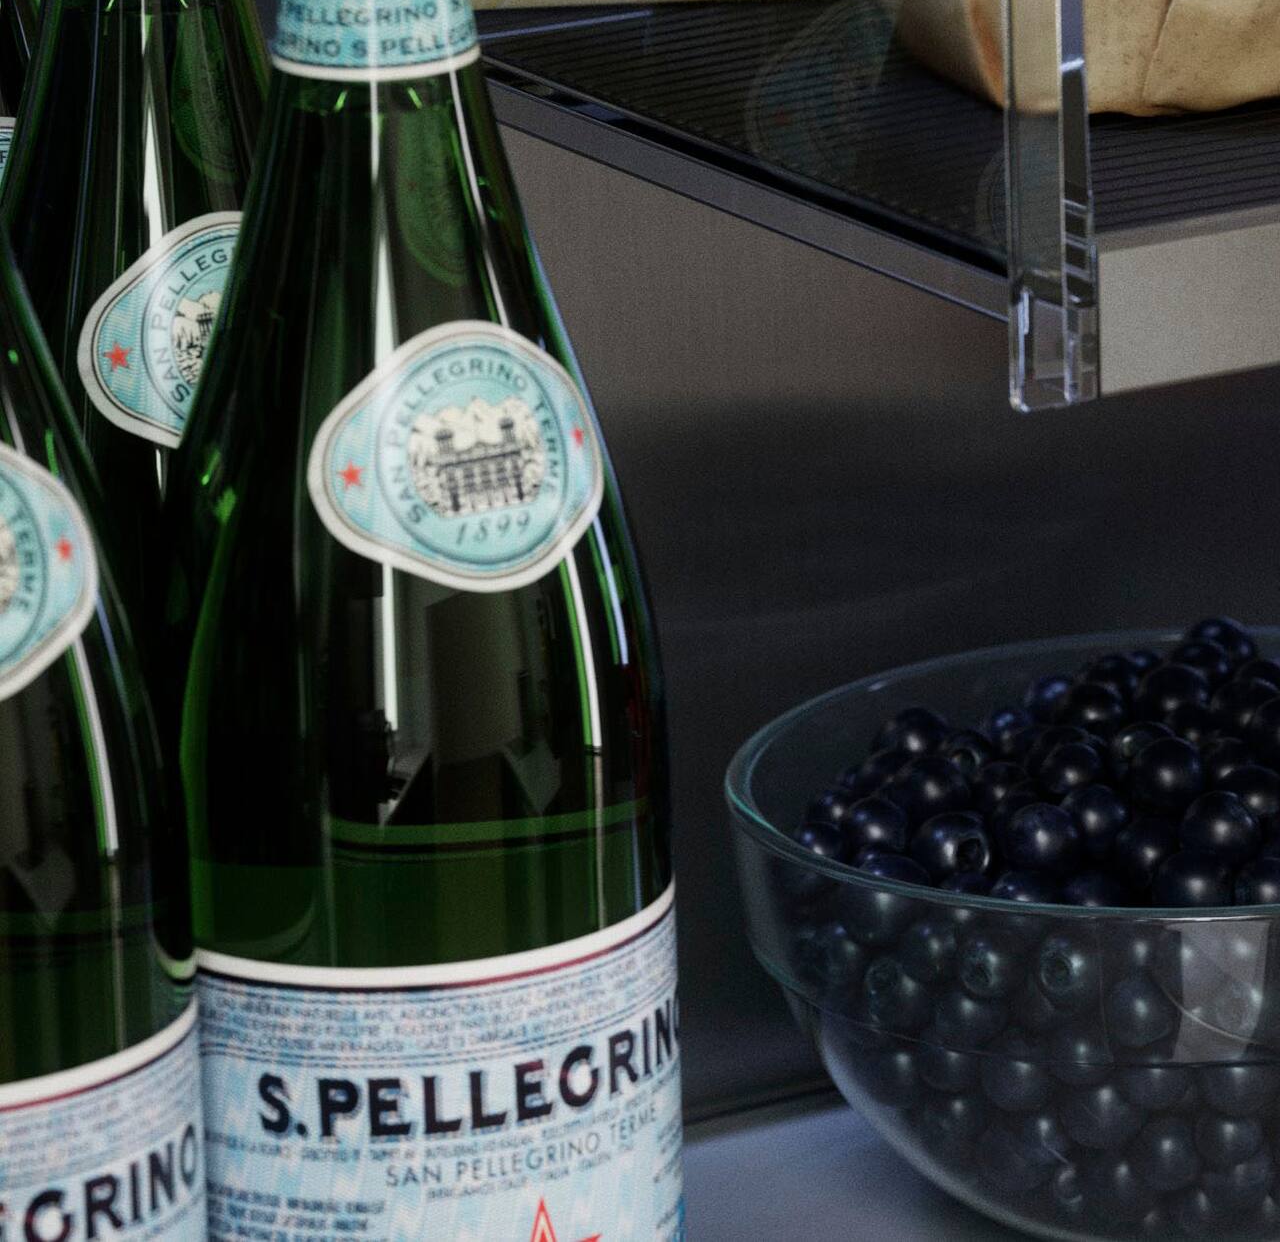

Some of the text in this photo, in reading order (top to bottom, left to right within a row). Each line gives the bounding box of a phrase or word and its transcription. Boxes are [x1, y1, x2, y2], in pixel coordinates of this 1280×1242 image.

[150, 246, 237, 404] SAN PELLEG
[385, 359, 529, 448] PELLEGRINO
[393, 463, 428, 525] SAN
[0, 1123, 198, 1242] GRINO
[385, 1163, 442, 1188] SAN
[456, 1131, 600, 1182] PELLEGRINO
[609, 1108, 657, 1143] TERME
